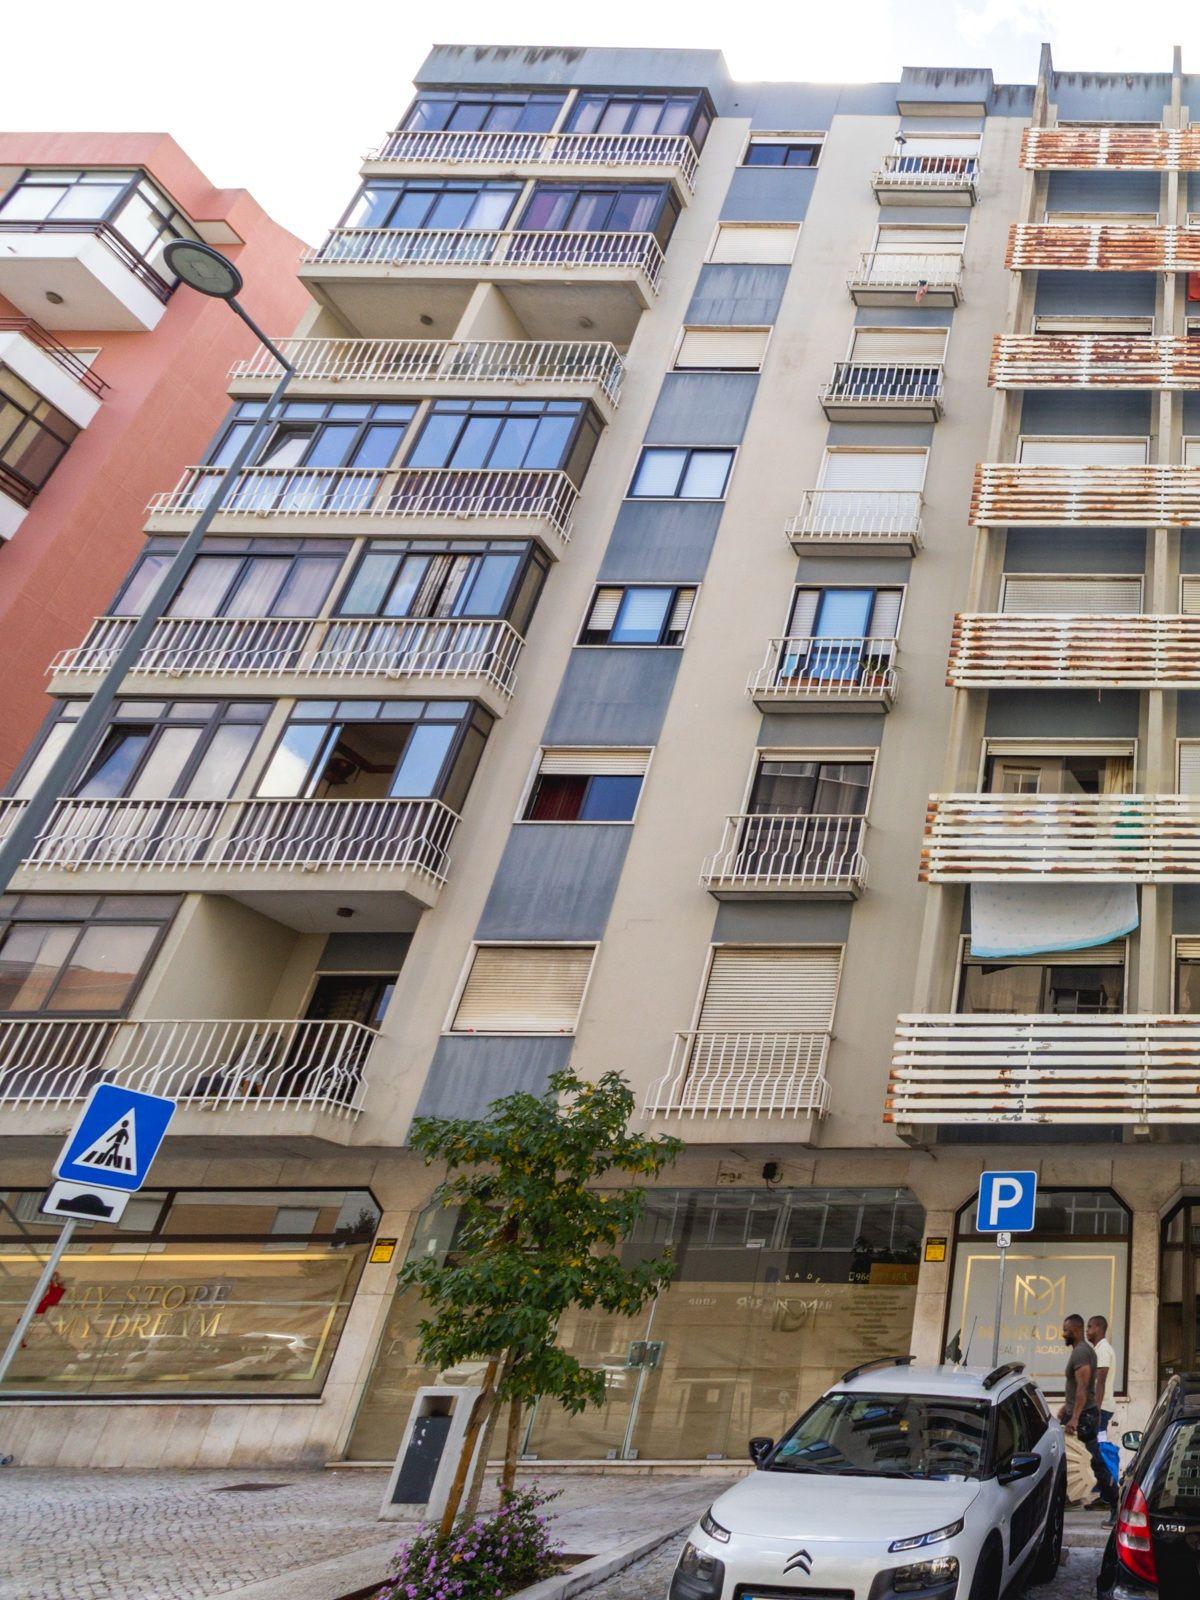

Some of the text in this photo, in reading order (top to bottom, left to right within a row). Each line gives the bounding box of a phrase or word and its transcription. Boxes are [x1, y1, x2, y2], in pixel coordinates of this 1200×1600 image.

[989, 1177, 1023, 1225] P
[66, 1285, 232, 1310] MY STORE
[57, 1312, 224, 1339] MY DREAM
[1157, 1523, 1186, 1533] A150
